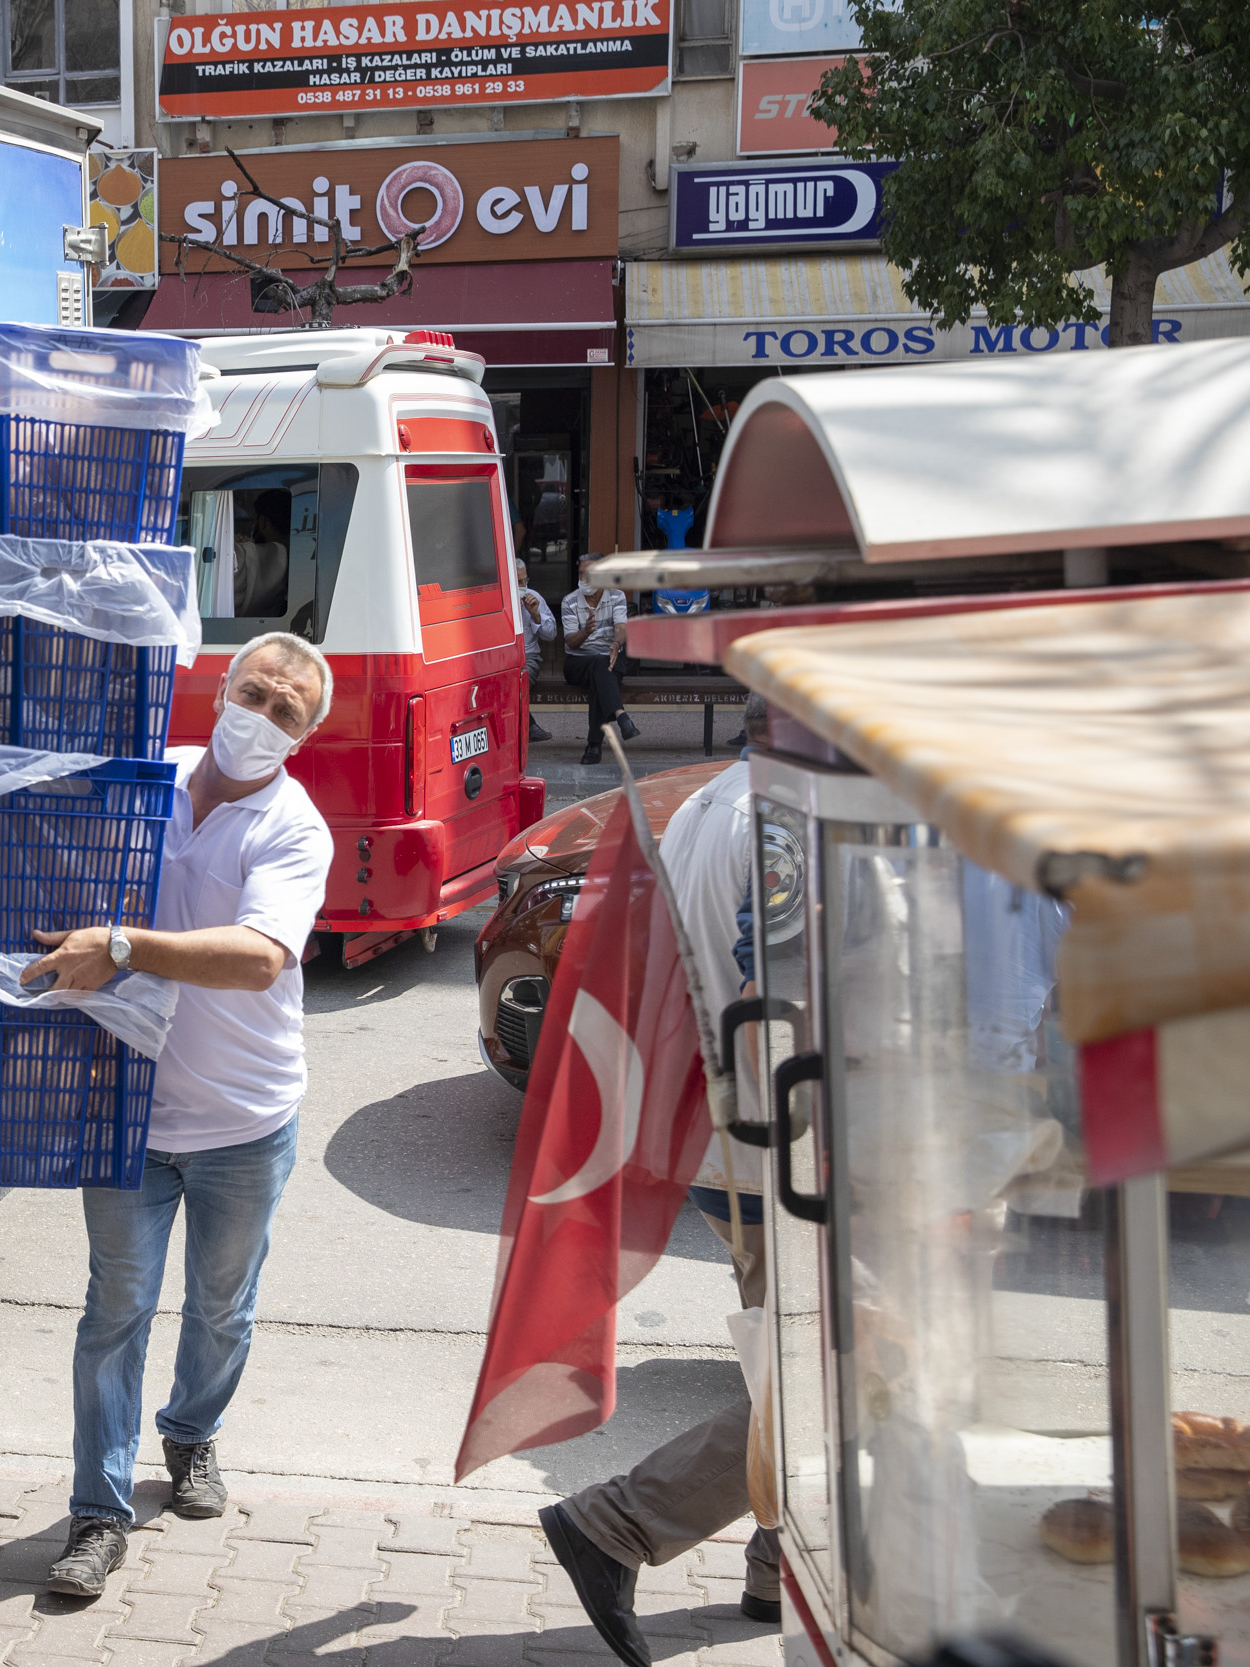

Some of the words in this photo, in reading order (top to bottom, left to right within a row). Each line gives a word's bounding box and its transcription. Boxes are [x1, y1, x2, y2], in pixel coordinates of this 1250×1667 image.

[169, 18, 283, 55] OLĞUN
[291, 14, 407, 48] HASAR
[415, 0, 662, 42] DANIŞMANLIK
[196, 61, 250, 77] TRAFİK
[253, 58, 327, 74] KAZALARI
[342, 54, 356, 71] İŞ
[361, 50, 436, 68] KAZALARI
[451, 46, 496, 62] ÖLÜM
[501, 46, 521, 59] VE
[525, 40, 632, 57] SAKATLANMA
[309, 72, 361, 86] HASAR
[375, 67, 426, 82] DEĞER
[431, 63, 512, 79] KAYIPLARI
[298, 92, 332, 104] 0538
[336, 89, 361, 102] 487
[365, 89, 381, 100] 31
[388, 87, 404, 99] 13
[416, 85, 451, 97] 0538
[455, 84, 480, 95] 961
[485, 82, 503, 93] 29
[507, 80, 525, 92] 33
[754, 93, 830, 119] STI
[183, 176, 361, 246] simit
[476, 162, 589, 235] evi
[709, 180, 834, 232] yağmur
[743, 326, 935, 358] TOROS
[970, 319, 1183, 353] MOTR
[455, 738, 463, 759] 33
[464, 735, 471, 756] M
